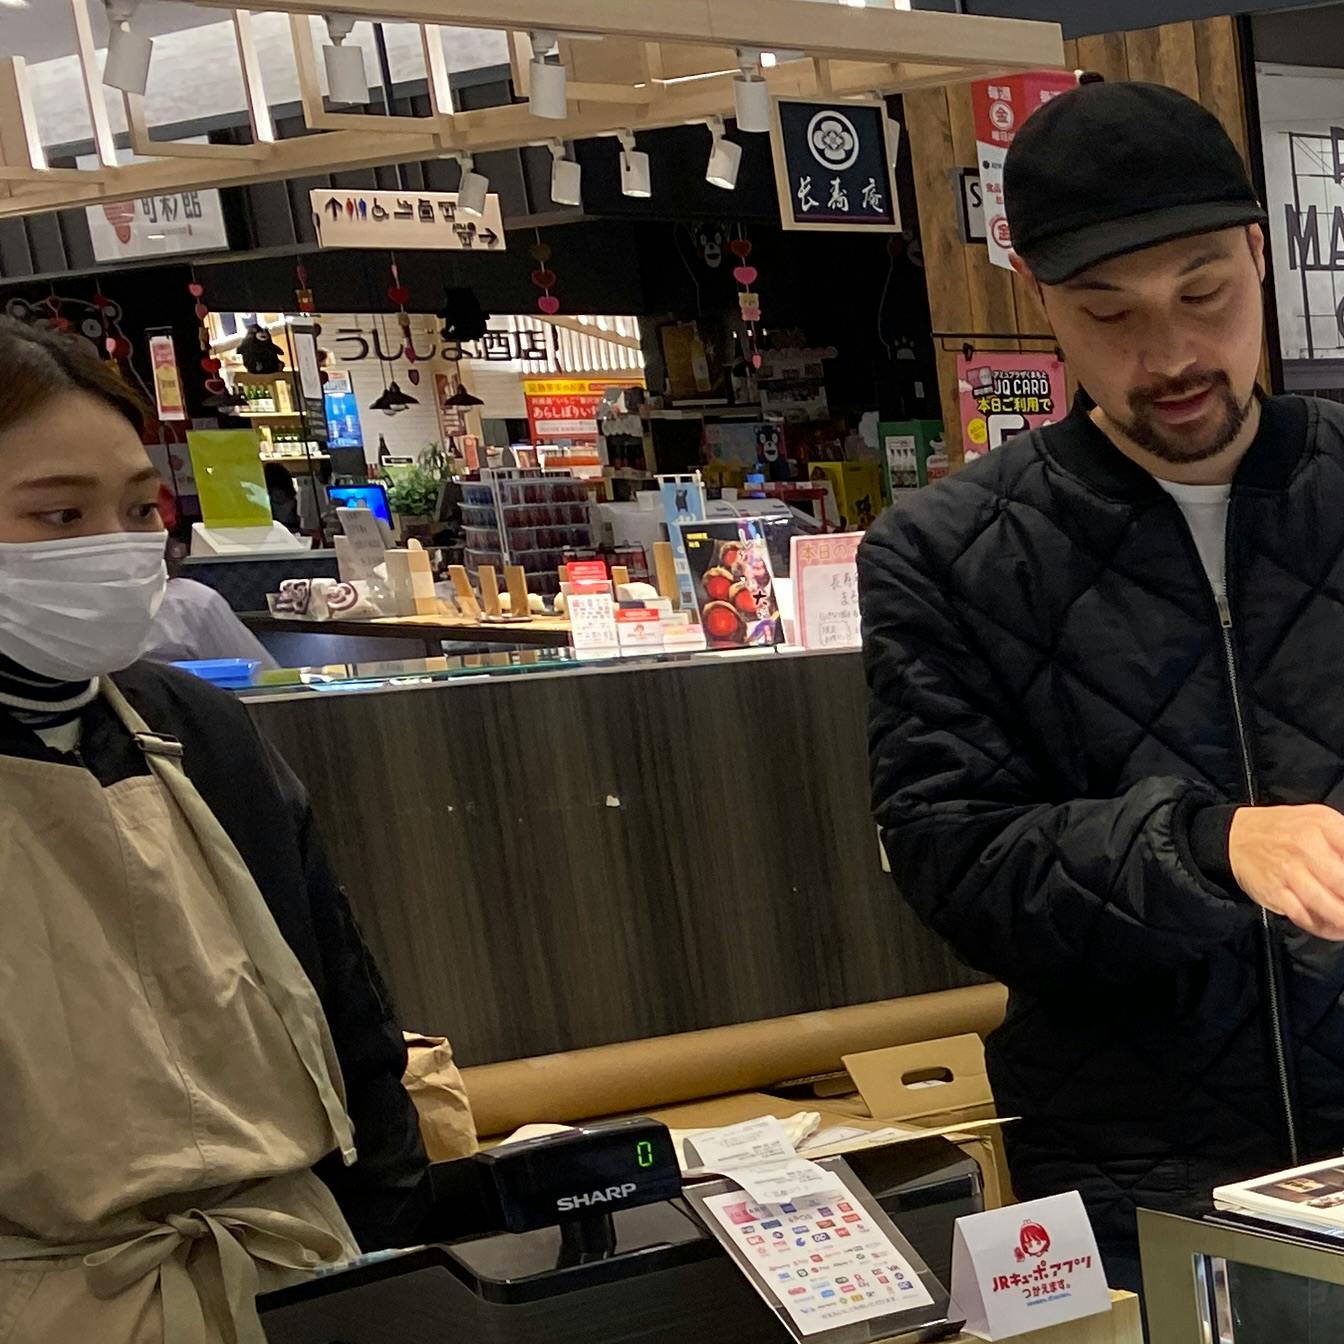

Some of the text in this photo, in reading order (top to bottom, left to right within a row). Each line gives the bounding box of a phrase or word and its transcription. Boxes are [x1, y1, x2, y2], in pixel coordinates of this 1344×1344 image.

[1013, 379, 1049, 395] CARD
[977, 397, 1051, 412] 本日ご利用で
[637, 1141, 653, 1168] 0
[556, 1182, 637, 1213] SHARP
